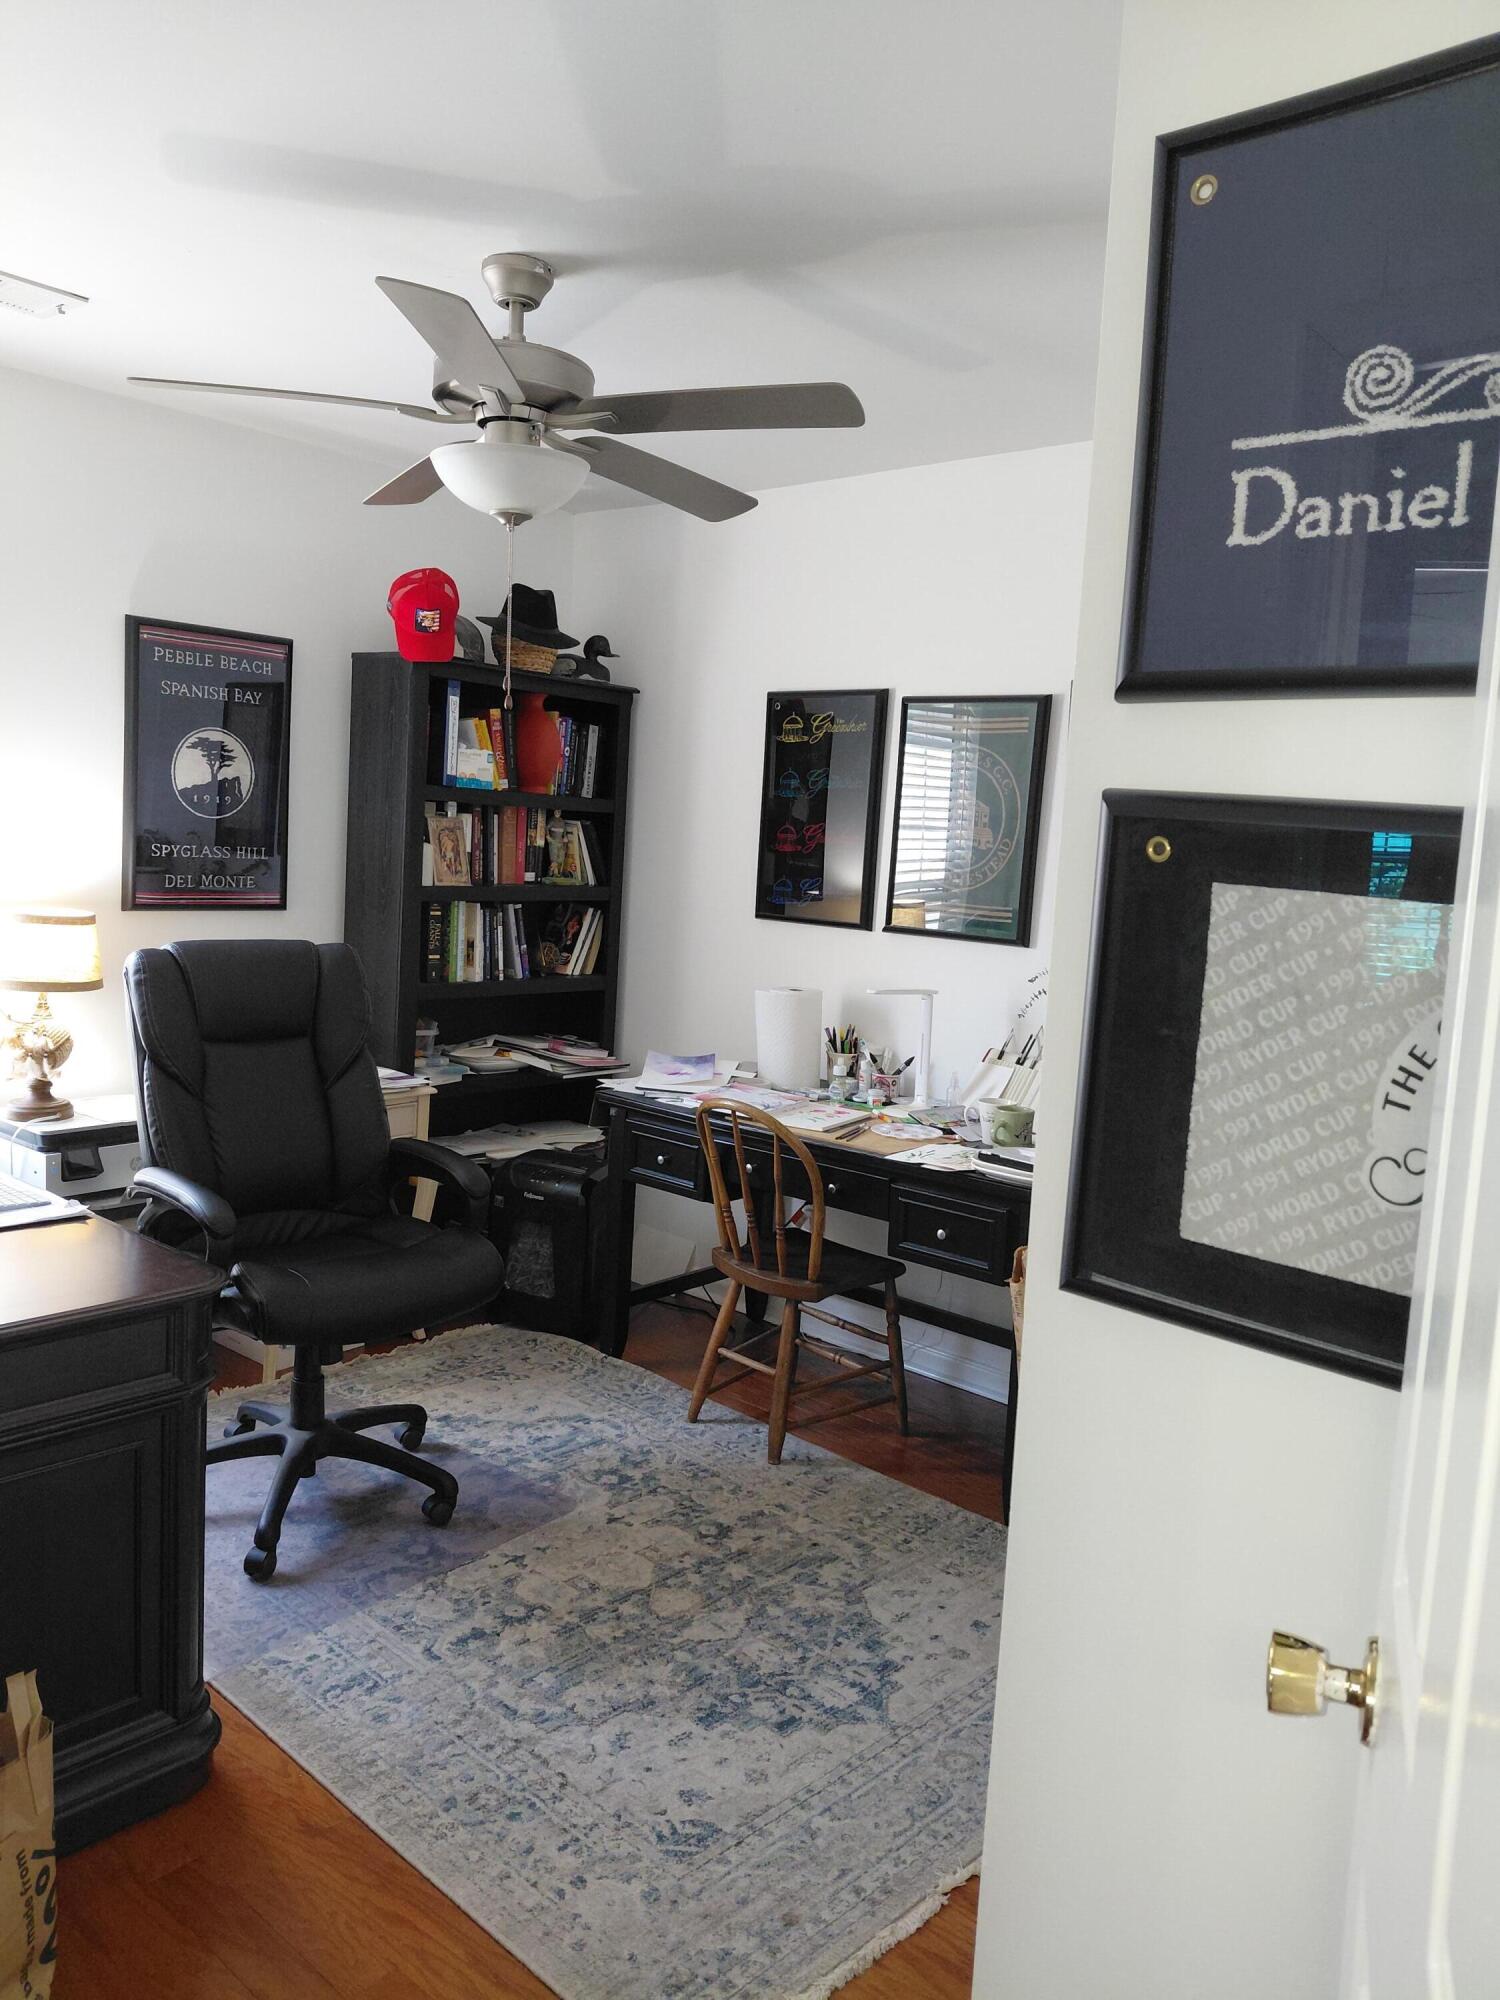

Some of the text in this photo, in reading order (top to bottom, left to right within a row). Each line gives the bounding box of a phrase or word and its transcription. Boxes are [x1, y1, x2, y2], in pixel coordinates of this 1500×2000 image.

[1225, 440, 1473, 547] Daniel
[153, 647, 273, 676] PEBBLE BEACH
[160, 680, 262, 705] SPANISH BAY
[193, 794, 231, 806] 1919
[151, 843, 269, 860] SPYGLASS HILL
[165, 874, 256, 889] DEL MONTE
[1211, 890, 1240, 923] UP
[1248, 895, 1288, 930] CUP
[1229, 943, 1269, 975] CUP
[1210, 973, 1278, 1018] RYDER
[1277, 949, 1318, 982] CUP
[1258, 995, 1297, 1028] CUP
[1195, 1059, 1235, 1091] 991
[1237, 1026, 1306, 1071] RYDER
[1307, 1003, 1349, 1037] CUP
[1207, 1071, 1281, 1115] WORLD
[1285, 1050, 1328, 1082] CUP
[1381, 1042, 1439, 1112] THE
[1213, 1111, 1264, 1145] 1991
[1265, 1080, 1336, 1124] RYDER
[1335, 1059, 1380, 1092] CUP
[1190, 1157, 1234, 1189] 1997
[1235, 1126, 1311, 1170] WORLD
[1313, 1104, 1357, 1137] CUP
[1185, 1192, 1224, 1222] CUP
[1240, 1165, 1292, 1198] 1991
[1293, 1135, 1365, 1178] RYDER
[1212, 1211, 1260, 1243] 1997
[1263, 1181, 1341, 1223] WORLD
[1372, 1219, 1417, 1251] CUP
